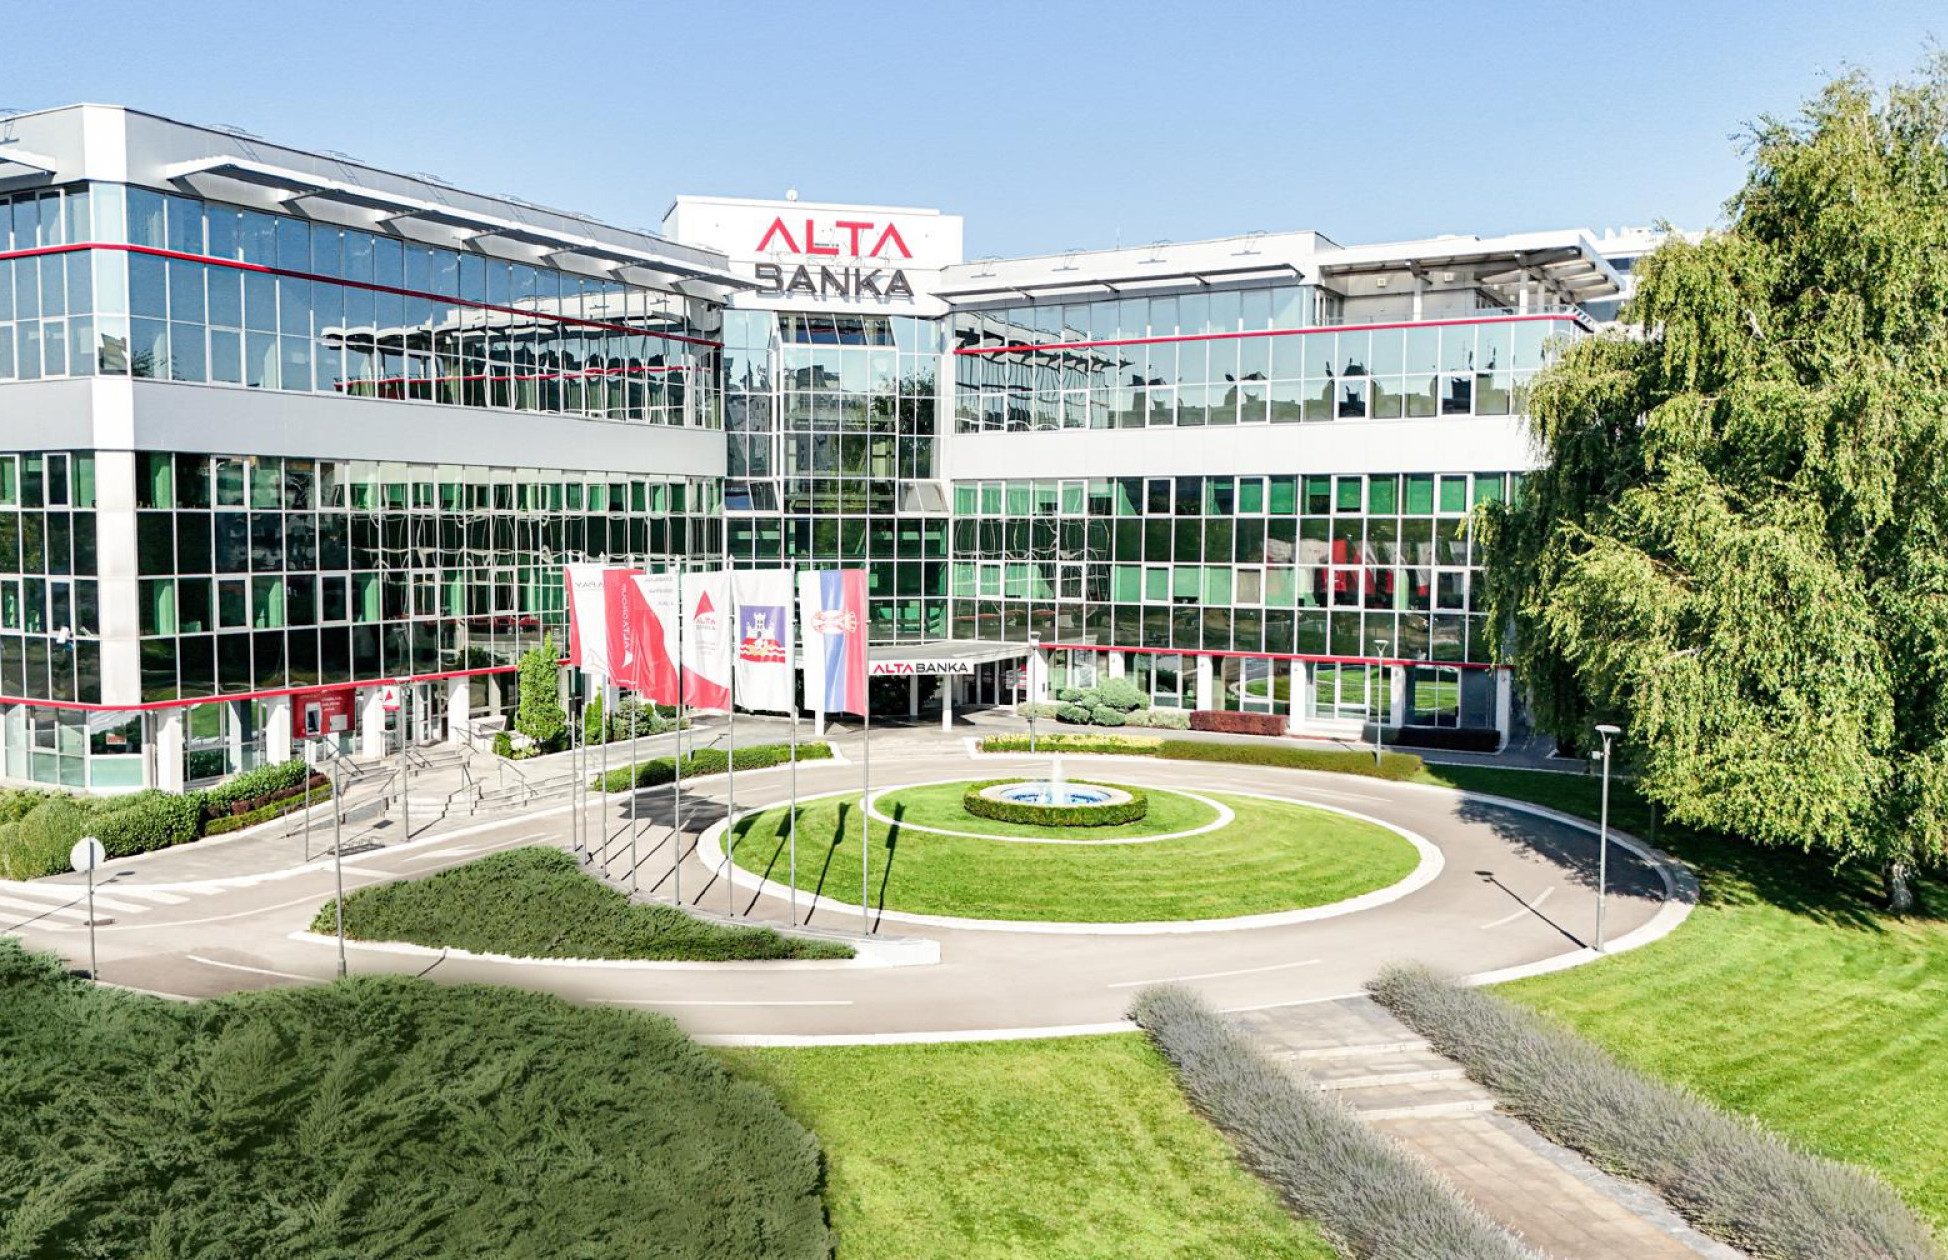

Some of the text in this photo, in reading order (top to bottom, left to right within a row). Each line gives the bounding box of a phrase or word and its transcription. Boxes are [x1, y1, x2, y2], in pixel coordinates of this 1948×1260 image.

[755, 216, 913, 259] ALTA
[755, 263, 915, 298] BANKA
[873, 662, 968, 674] ALTA BANKA
